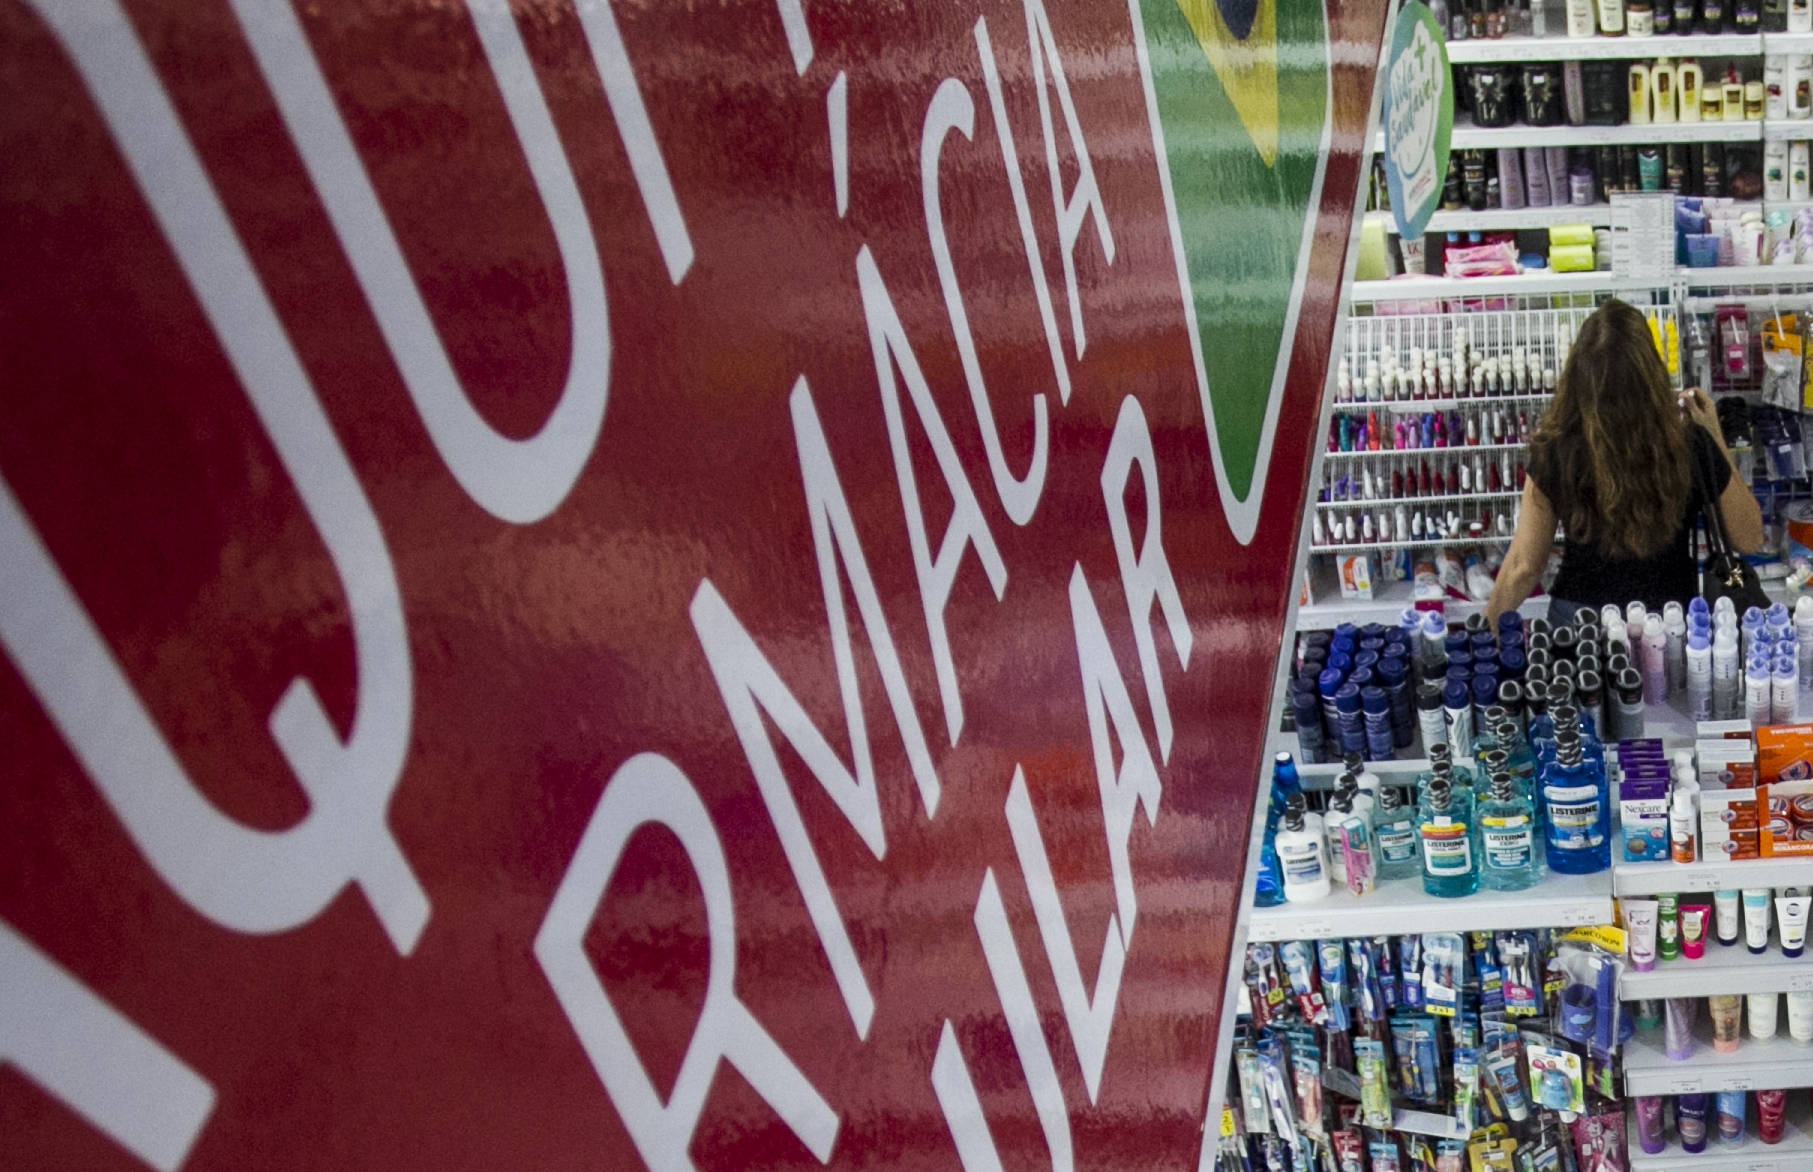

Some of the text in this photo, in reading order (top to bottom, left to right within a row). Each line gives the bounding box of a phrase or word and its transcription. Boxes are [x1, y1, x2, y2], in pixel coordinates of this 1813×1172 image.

[1550, 804, 1598, 815] LISTERINE
[1624, 803, 1662, 815] Nexcare
[1489, 832, 1527, 841] LISTERINE
[1427, 839, 1466, 847] LISTERINE
